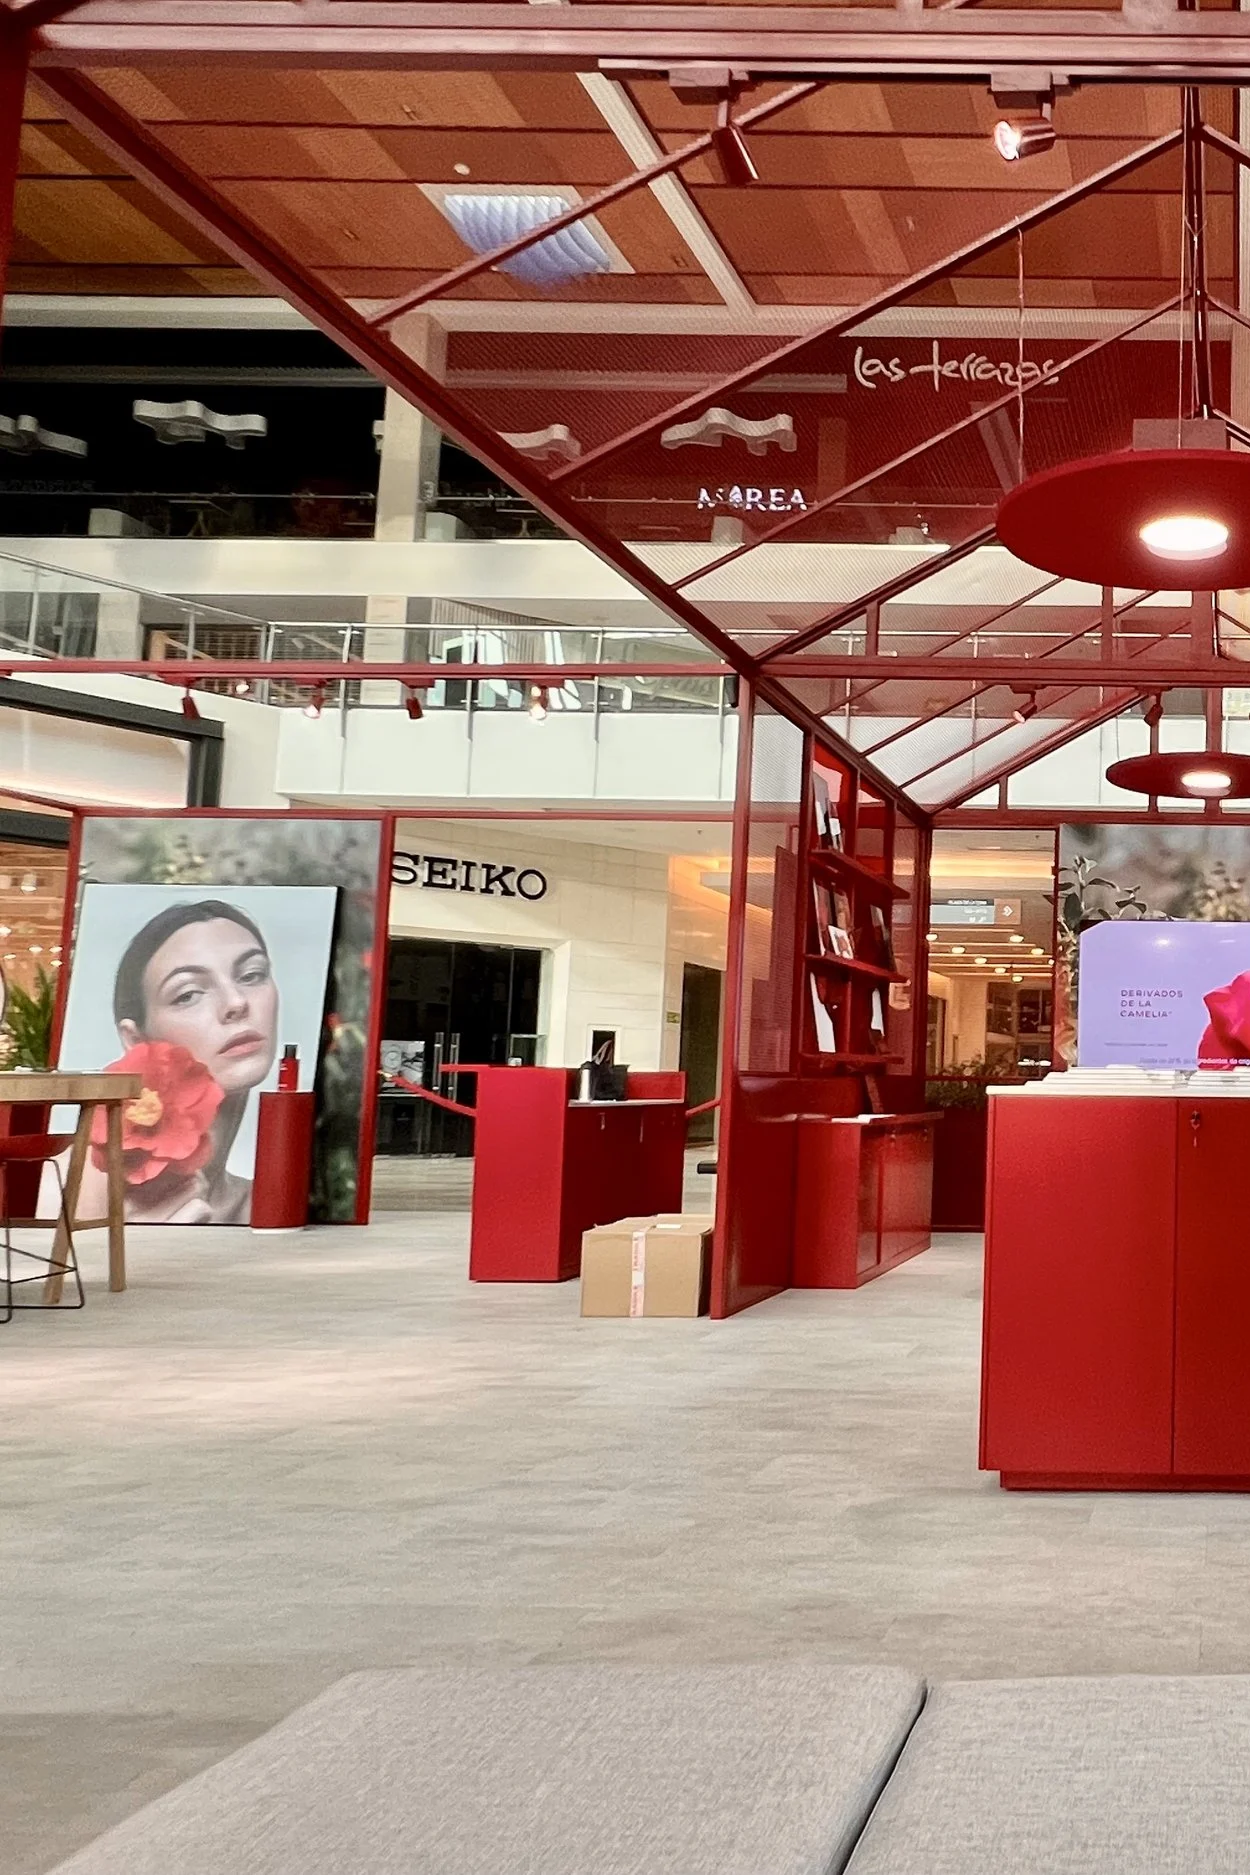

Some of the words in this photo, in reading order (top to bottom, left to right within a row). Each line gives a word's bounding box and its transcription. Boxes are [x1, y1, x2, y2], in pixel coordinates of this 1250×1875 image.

[854, 346, 906, 389] las
[909, 339, 1060, 392] terrazas
[391, 851, 548, 900] SEIKO
[1120, 989, 1183, 998] DERIVADOS
[1120, 1000, 1135, 1008] DE
[1138, 1000, 1152, 1008] LA
